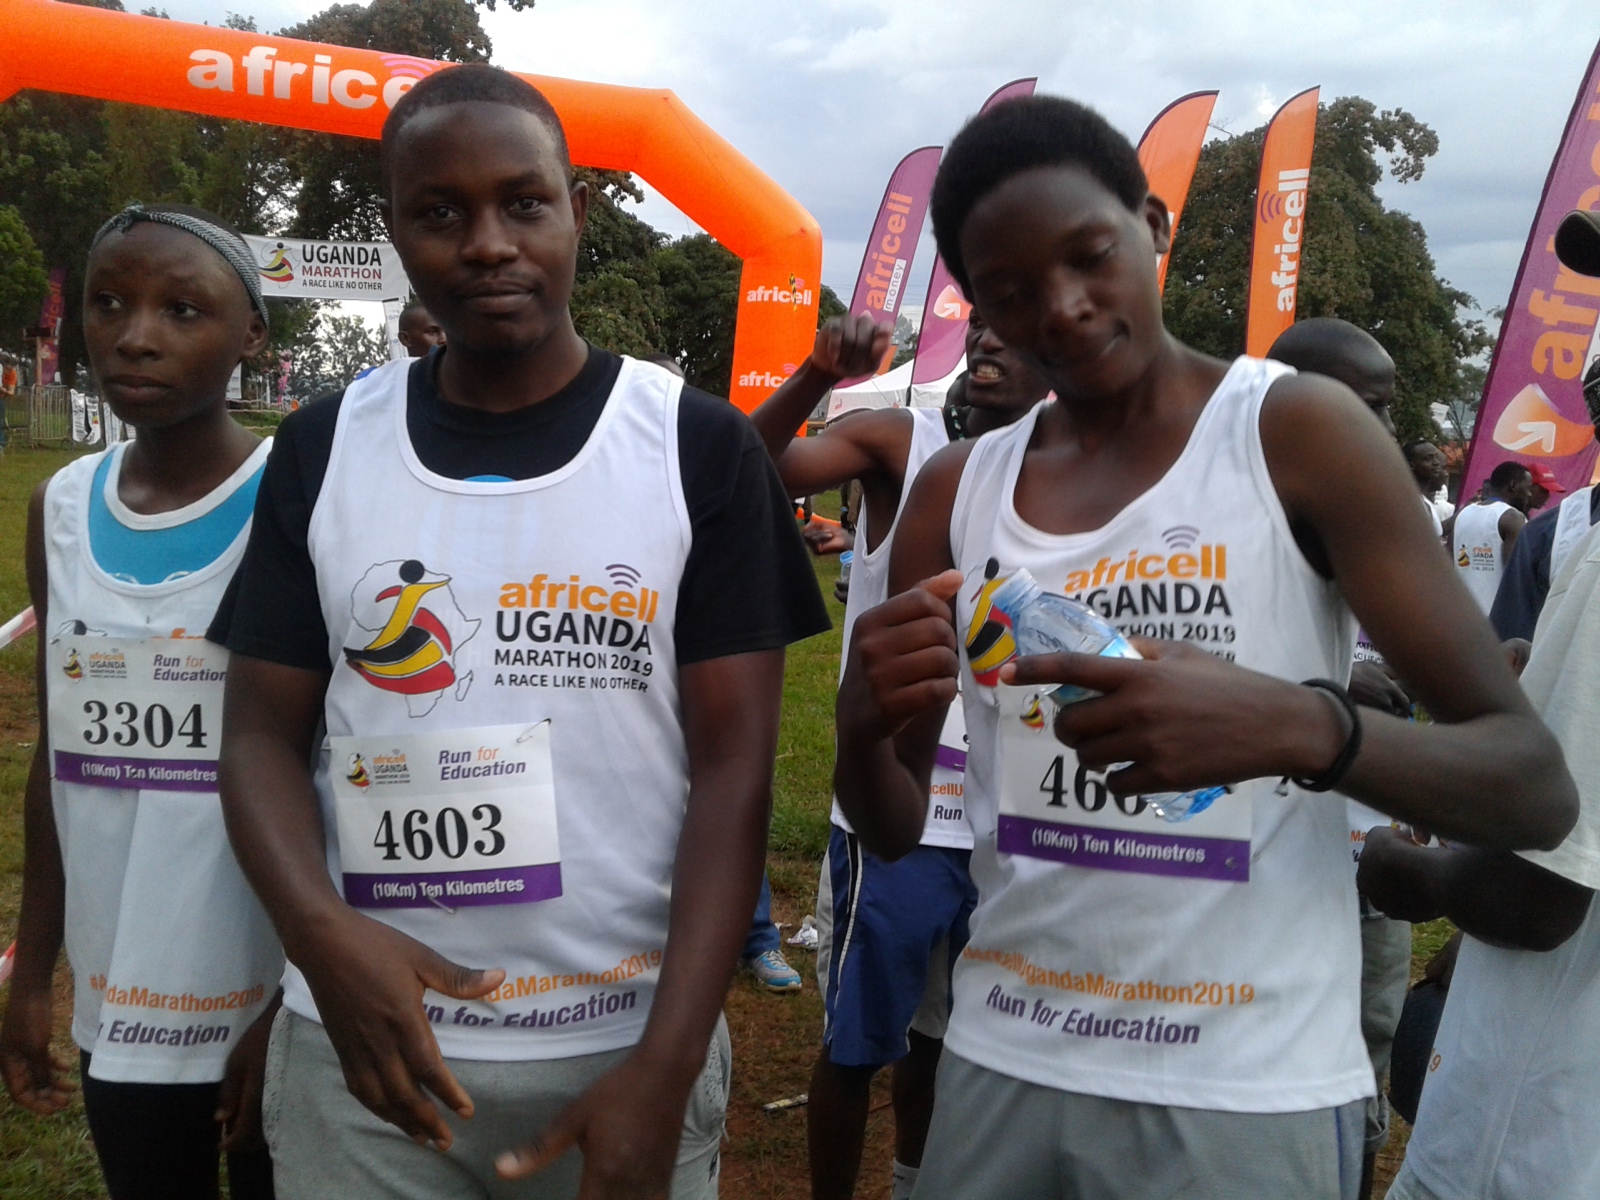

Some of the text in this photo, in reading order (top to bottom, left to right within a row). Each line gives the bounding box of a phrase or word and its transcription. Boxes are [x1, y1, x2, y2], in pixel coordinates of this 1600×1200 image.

[865, 192, 913, 310] africell
[1271, 168, 1310, 312] africell
[302, 244, 382, 266] UGANDA
[302, 265, 382, 280] MARATHON
[309, 280, 327, 288] RACE
[328, 280, 344, 289] LIKE
[346, 281, 357, 289] NO
[358, 281, 382, 291] OTHER
[747, 286, 812, 306] africell
[884, 263, 905, 310] money
[739, 371, 788, 388] afric
[1064, 544, 1226, 593] africell
[499, 574, 659, 623] africell
[1074, 582, 1232, 619] GANDA
[496, 610, 653, 656] UGANDA
[1182, 622, 1236, 643] 2019
[153, 654, 206, 668] Run for
[494, 649, 653, 677] MARATHON 2019
[494, 674, 648, 693] A RACE LIKE NO OTHER
[83, 700, 207, 748] 3304
[438, 746, 500, 765] Run for
[81, 762, 121, 781] (10Km)
[148, 766, 217, 782] Kilometres
[440, 761, 526, 781] Education
[934, 805, 962, 820] Run
[374, 804, 505, 861] 4603
[1032, 827, 1206, 863] (10Km) Ten Kilometres
[373, 878, 525, 900] (10Km) Ten Kilometres
[480, 949, 662, 1003] daMarathon2019
[452, 1006, 494, 1027] for
[502, 991, 637, 1028] Education
[986, 984, 1200, 1044] Run for Education
[107, 1020, 231, 1046] Education
